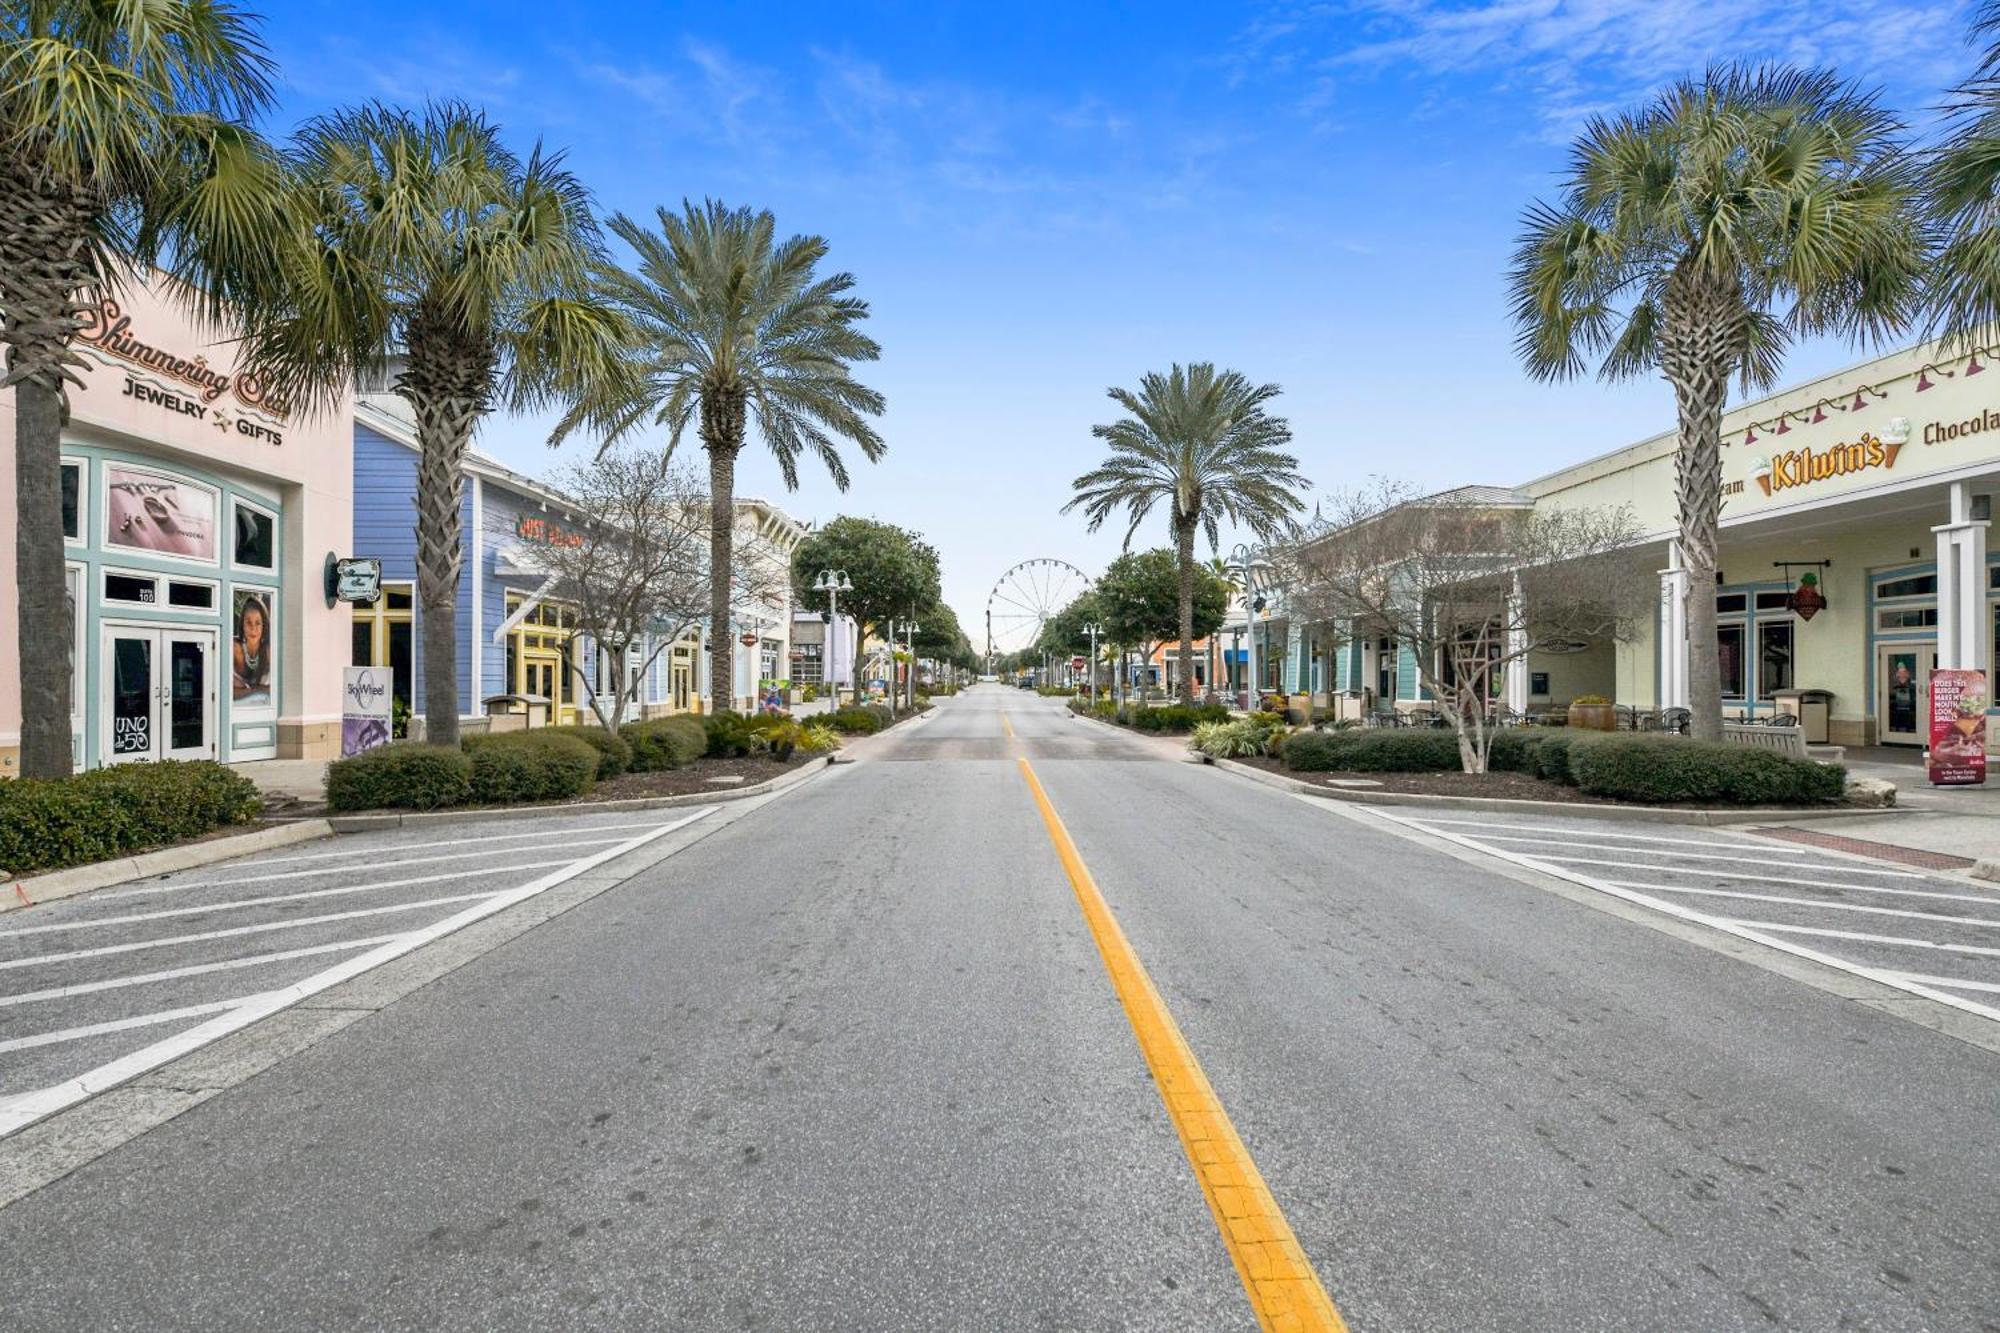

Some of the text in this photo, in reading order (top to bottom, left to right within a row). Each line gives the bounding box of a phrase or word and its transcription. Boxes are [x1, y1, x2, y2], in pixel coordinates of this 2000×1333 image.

[72, 298, 230, 403] Shimmering
[122, 377, 283, 446] JEWELRY GIFTS
[1924, 408, 2000, 446] Chocola
[1772, 432, 1885, 491] Kilwin's
[139, 593, 154, 602] 100
[347, 683, 385, 699] SkyWheel
[116, 716, 148, 733] UNO
[125, 732, 149, 750] 50
